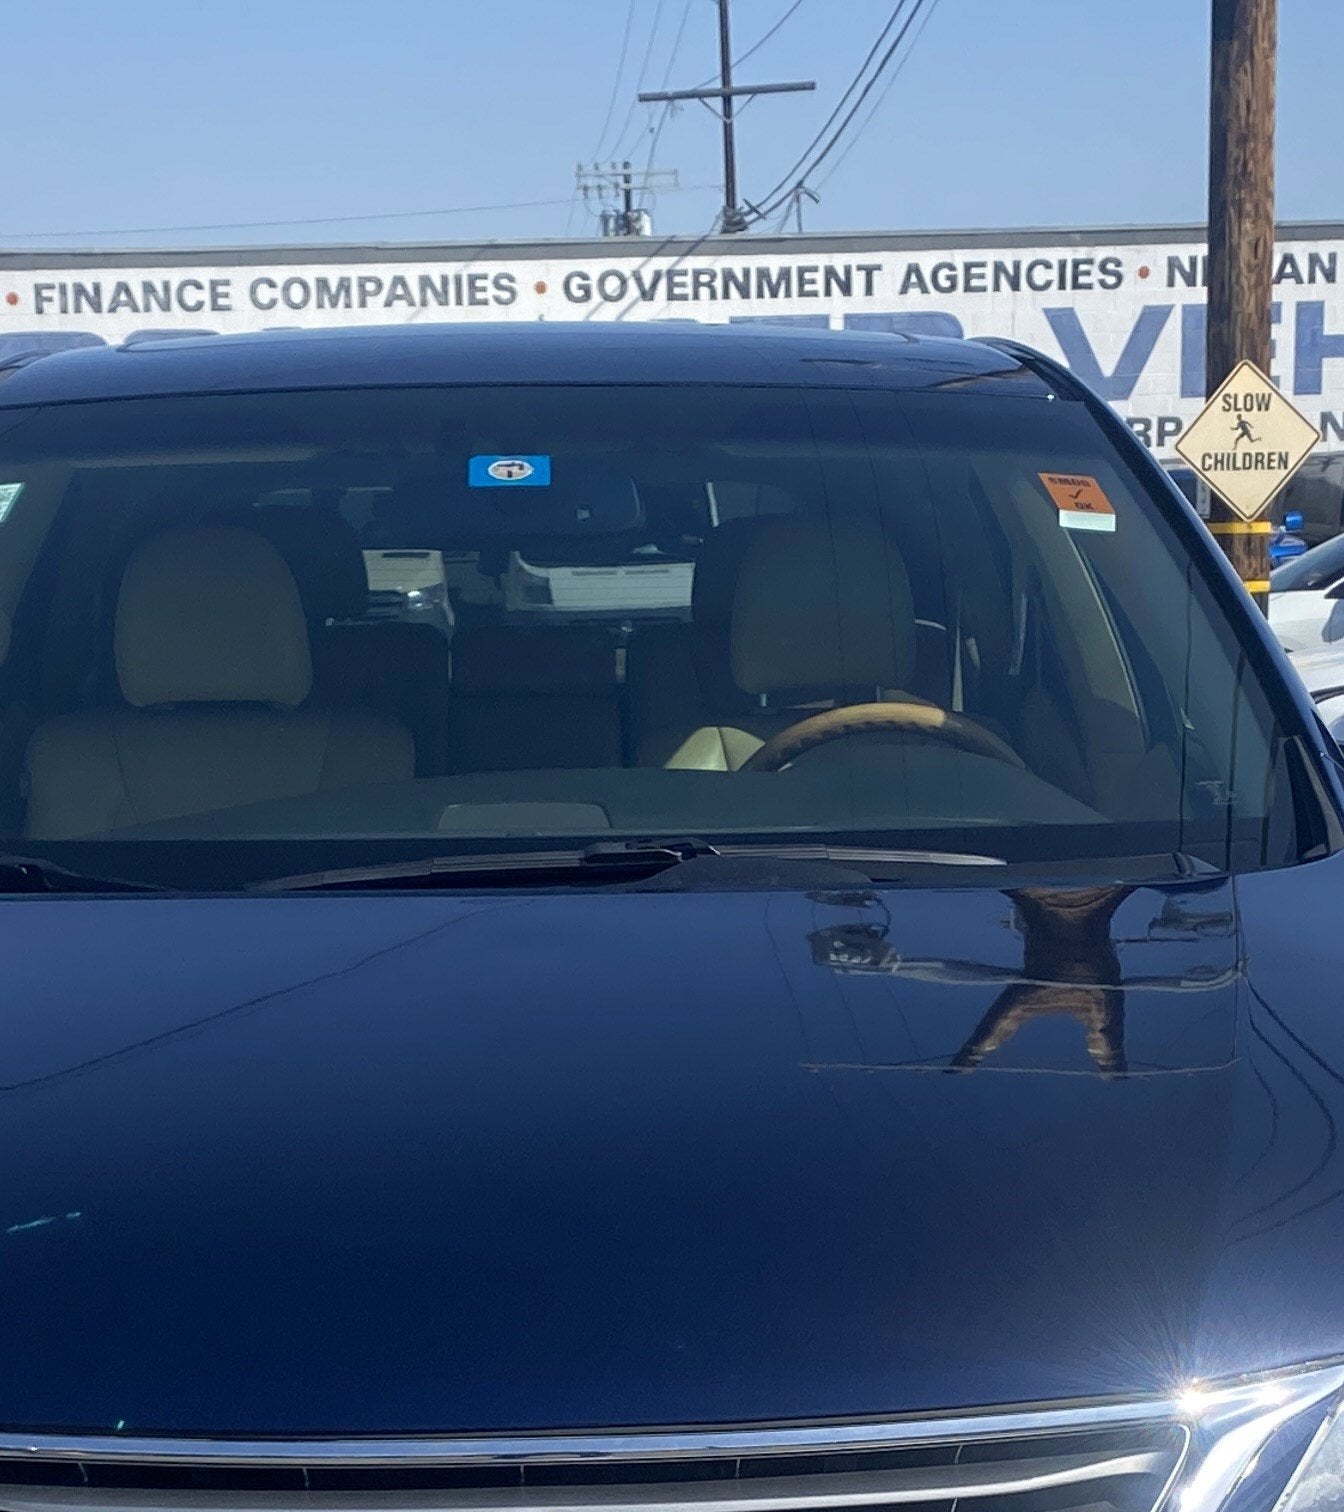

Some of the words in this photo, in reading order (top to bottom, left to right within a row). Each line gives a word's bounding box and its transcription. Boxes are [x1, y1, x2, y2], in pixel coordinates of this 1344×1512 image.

[33, 279, 232, 316] FINANCE
[249, 272, 518, 311] COMPANIES
[562, 263, 882, 304] GOVERNMENT
[899, 256, 1123, 296] AGENCIES
[1166, 252, 1338, 288] NIAN
[1221, 392, 1272, 412] SLOW
[1201, 451, 1290, 472] CHILDREN
